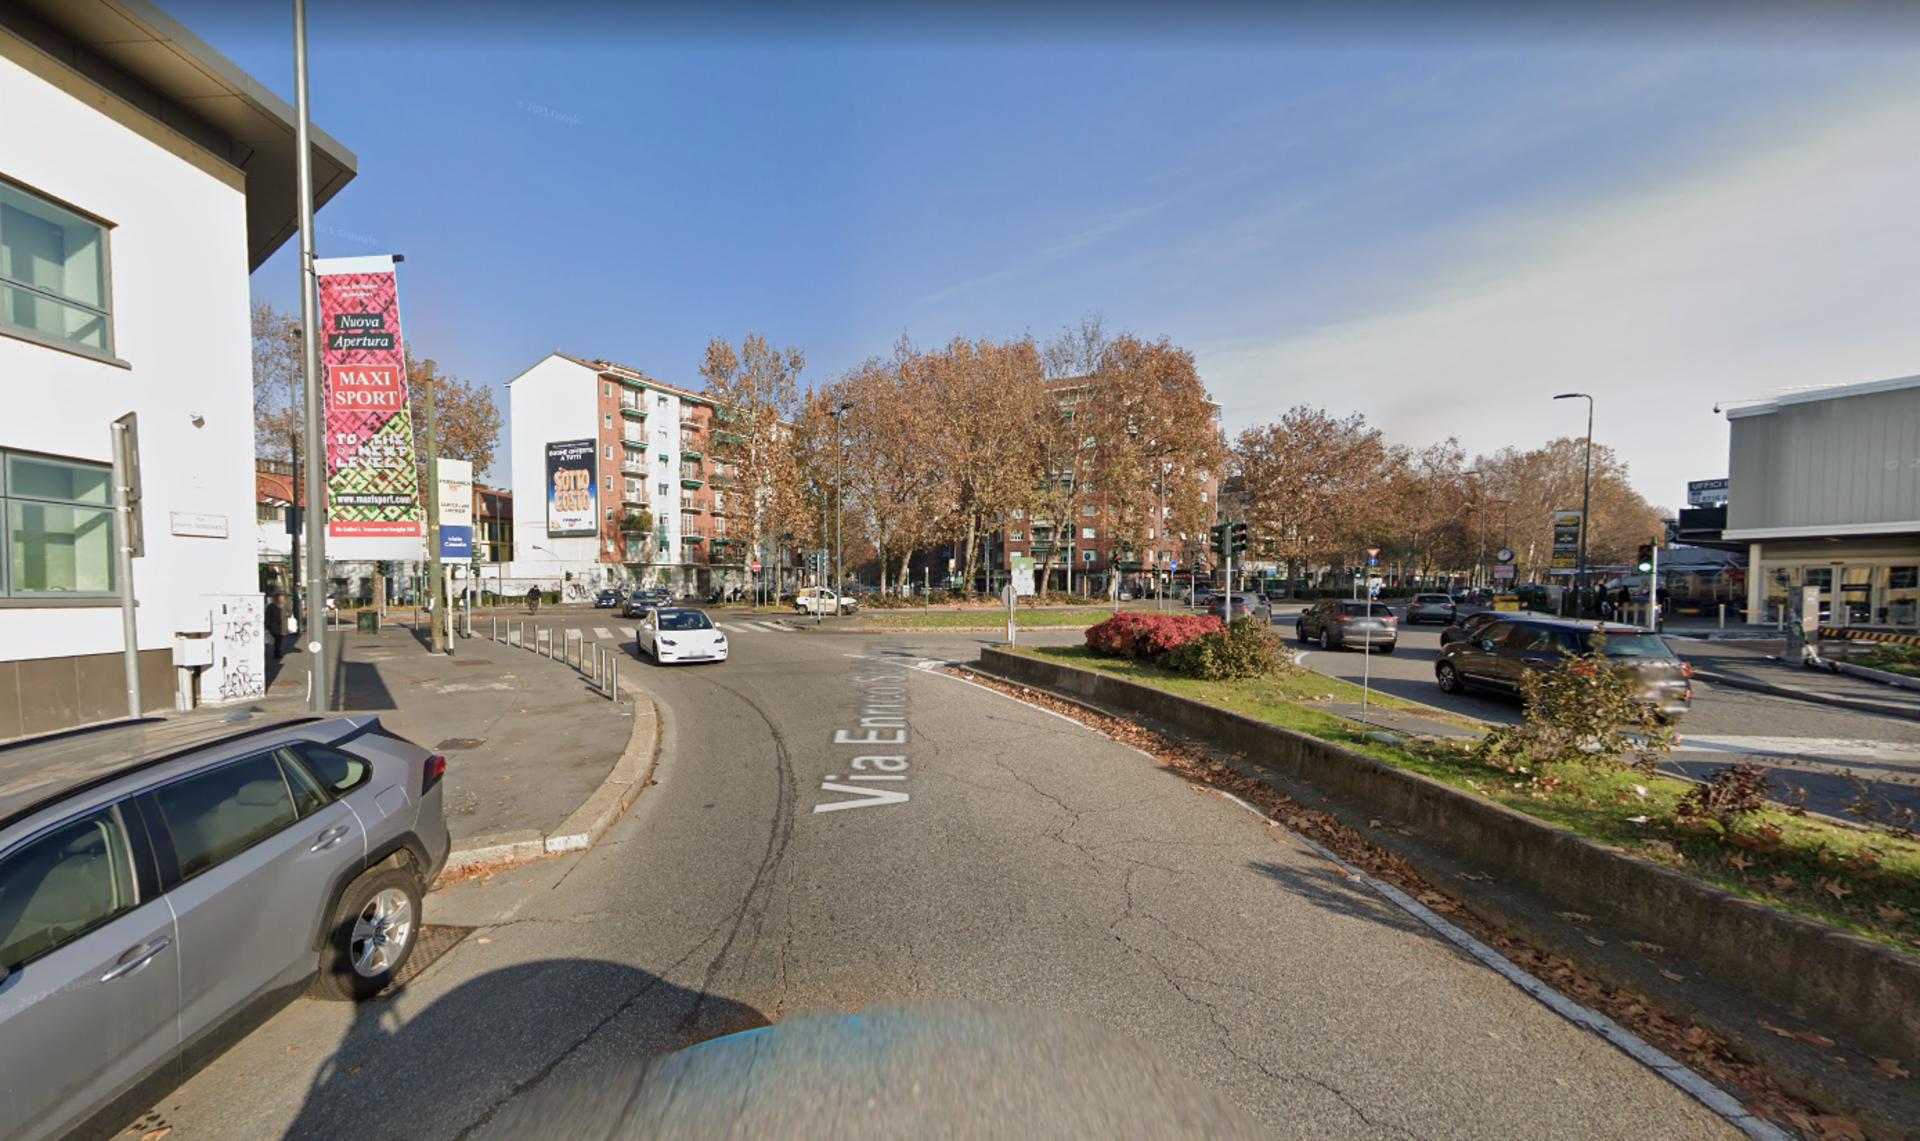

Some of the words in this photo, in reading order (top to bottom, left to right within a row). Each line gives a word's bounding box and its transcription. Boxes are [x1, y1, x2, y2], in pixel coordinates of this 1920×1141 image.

[340, 316, 380, 328] Nuova
[334, 335, 389, 350] Apertura
[339, 371, 391, 386] MAXI
[335, 390, 398, 405] SPORT
[336, 433, 357, 445] TO
[554, 469, 590, 490] SOTTO
[337, 495, 412, 505] www.maxisport.com
[554, 490, 590, 512] COSTO
